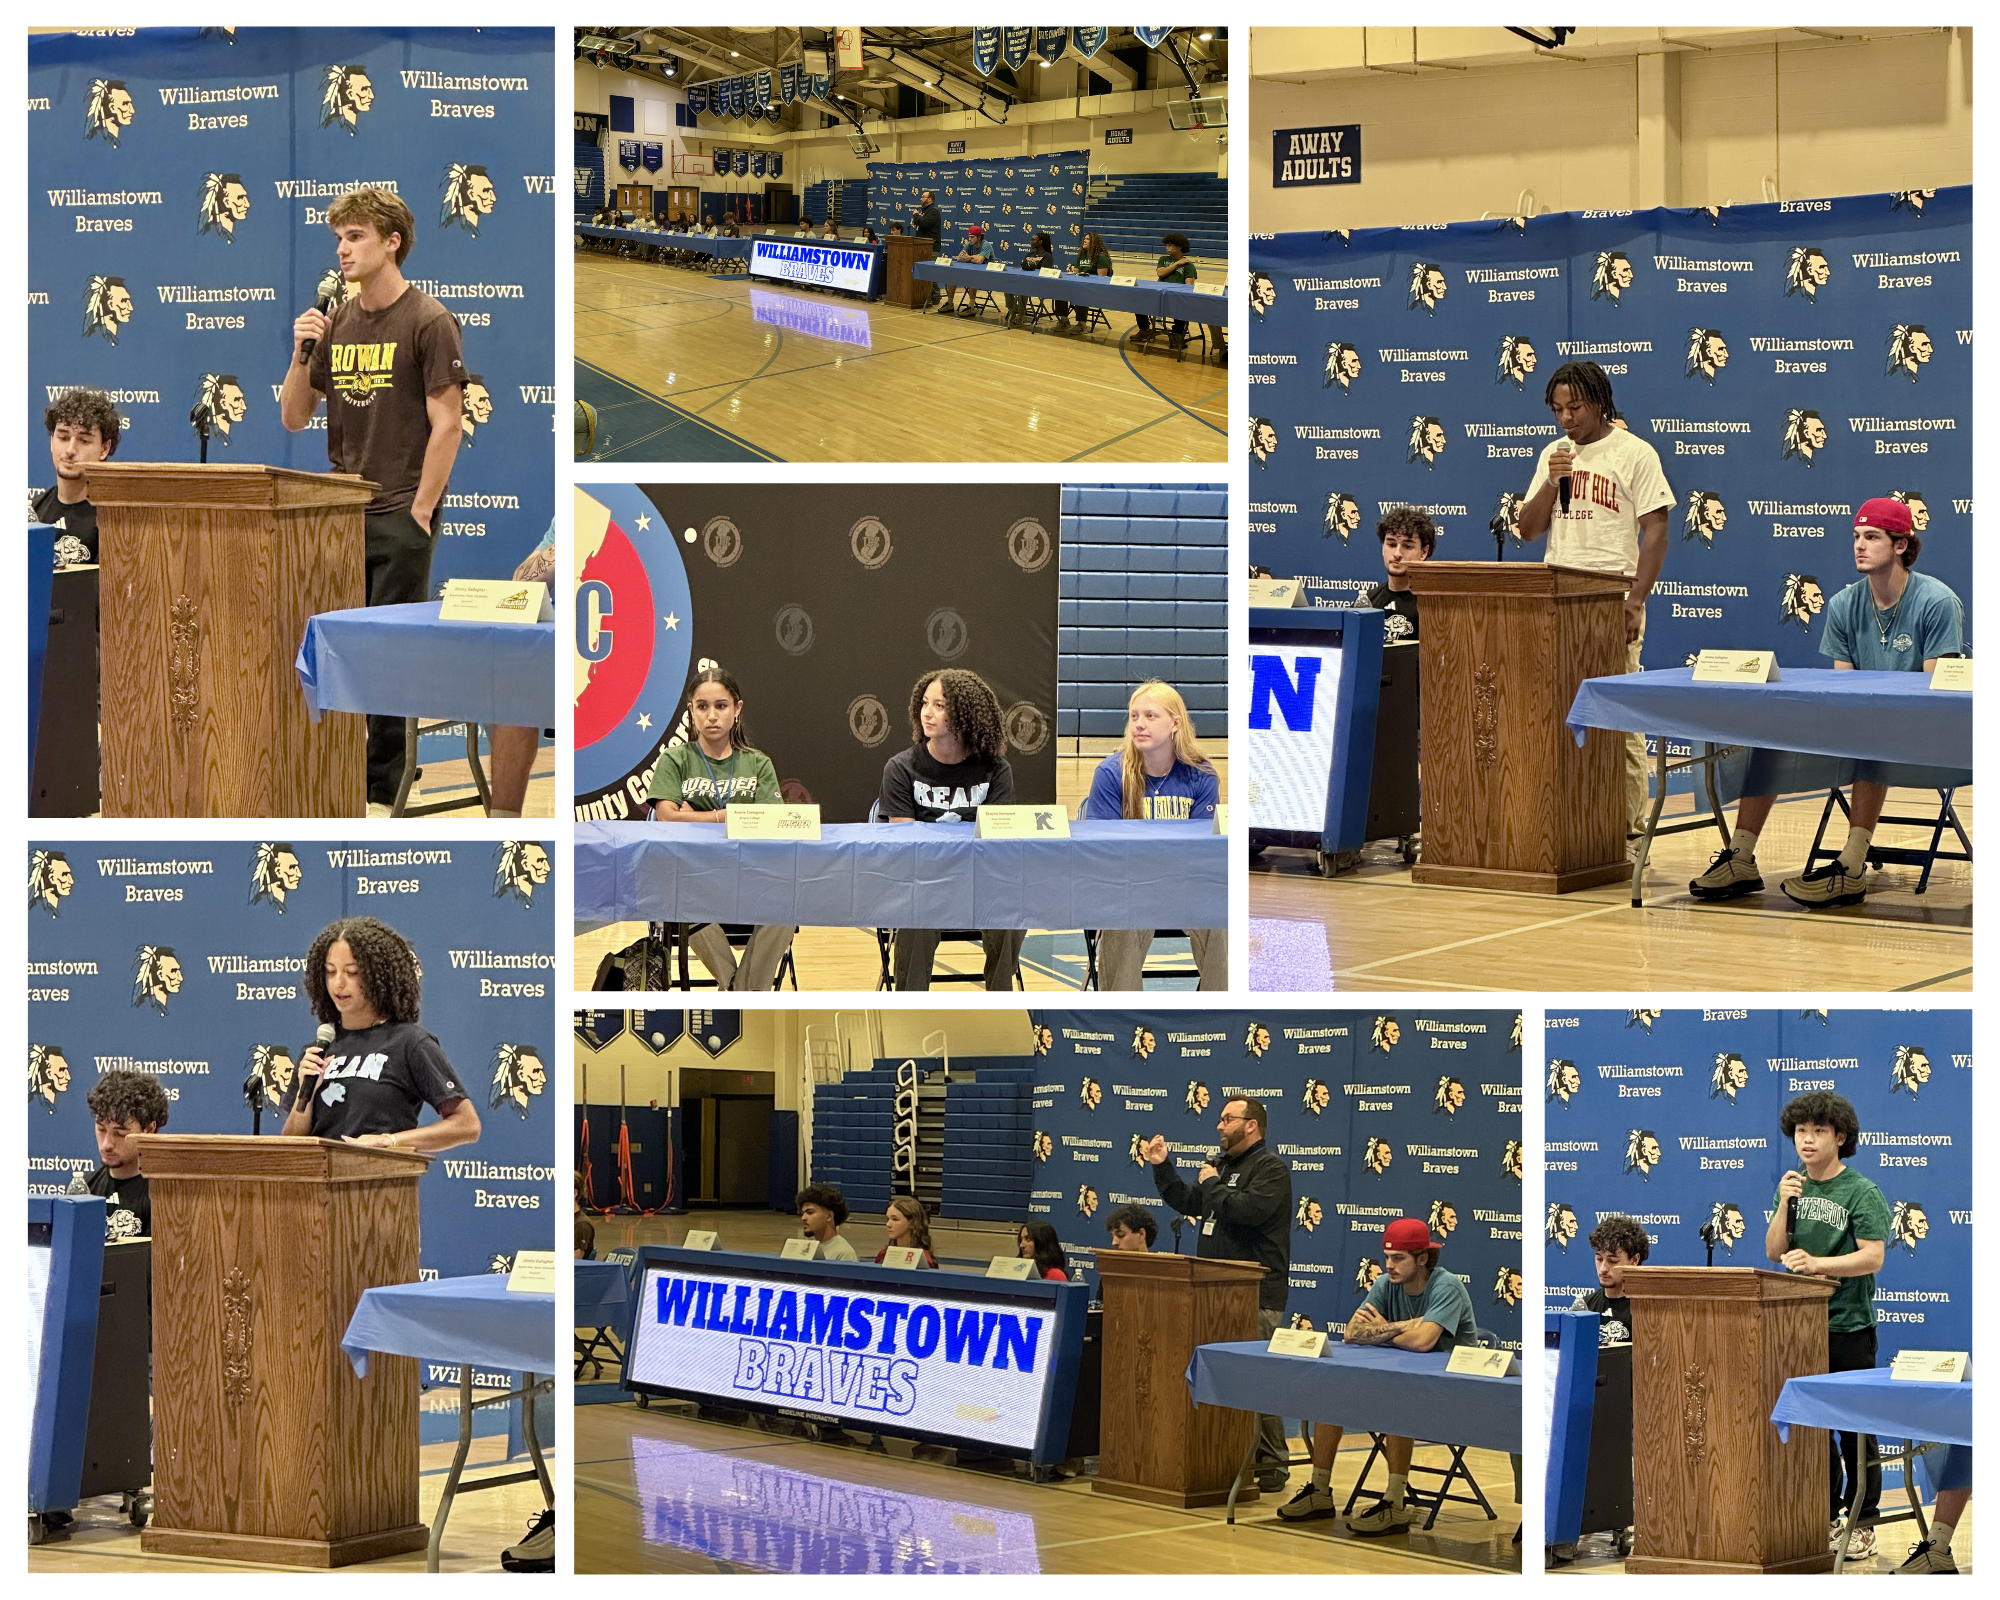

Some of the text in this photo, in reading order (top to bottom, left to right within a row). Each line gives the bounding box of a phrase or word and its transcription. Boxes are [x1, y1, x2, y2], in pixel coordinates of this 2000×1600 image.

[400, 71, 528, 90] Williamstown
[159, 86, 279, 105] Williamstown
[431, 100, 494, 118] Braves
[189, 114, 247, 130] Braves
[1288, 132, 1344, 155] AWAY
[1281, 157, 1352, 181] ADULTS
[47, 190, 162, 206] Williamstown
[1779, 200, 1831, 212] Braves
[305, 207, 331, 224] Bra
[76, 216, 132, 232] Braves
[757, 243, 870, 271] WILLIAMSTOWN
[1654, 256, 1753, 271] Williamstown
[1852, 252, 1960, 267] Williamstown
[780, 261, 834, 283] BRAVES
[1466, 268, 1559, 283] Williamstown
[1293, 278, 1381, 291] Williamstown
[1677, 279, 1727, 292] Braves
[1878, 275, 1931, 288] Braves
[157, 286, 275, 303] Williamstown
[1489, 290, 1535, 302] Braves
[1315, 298, 1358, 310] Braves
[186, 313, 244, 329] Braves
[1556, 341, 1652, 355] Williamstown
[1750, 338, 1854, 351] Williamstown
[331, 343, 397, 372] ROWAN
[1379, 349, 1468, 362] Williamstown
[1775, 360, 1826, 372] Braves
[1250, 375, 1276, 384] aves
[1401, 370, 1445, 382] Braves
[1465, 424, 1557, 438] Williamstown
[1651, 419, 1751, 432] Williamstown
[1849, 418, 1956, 432] Williamstown
[1295, 426, 1380, 438] Williamstown
[1316, 447, 1358, 459] Braves
[1487, 445, 1533, 457] Braves
[1675, 441, 1724, 454] Braves
[1875, 440, 1928, 453] Braves
[1592, 473, 1619, 513] HILL
[1748, 501, 1851, 515] Williamstown
[1250, 523, 1276, 532] aves
[1773, 524, 1824, 537] Braves
[1672, 604, 1722, 618] Braves
[681, 777, 757, 794] WAGNER
[914, 780, 990, 809] KEAN
[574, 785, 629, 823] unty
[327, 849, 451, 868] Williamstown
[97, 859, 213, 876] Williamstown
[357, 877, 419, 894] Braves
[126, 885, 183, 901] Braves
[207, 956, 307, 973] Williamsto
[449, 951, 555, 968] Williamsto
[29, 961, 98, 974] amstown
[237, 983, 296, 1000] Braves
[480, 979, 544, 997] Braves
[29, 989, 69, 1001] raves
[1703, 1011, 1747, 1021] Braves
[1284, 1028, 1348, 1038] Williamstown
[1415, 1020, 1486, 1033] Williamstown
[1062, 1029, 1114, 1041] Williamstown
[1168, 1033, 1226, 1042] Williamstown
[1075, 1044, 1101, 1054] Braves
[1298, 1044, 1331, 1053] Braves
[1431, 1038, 1466, 1049] Braves
[1181, 1047, 1210, 1056] Braves
[324, 1053, 389, 1082] EAN
[1767, 1058, 1858, 1071] Williamstown
[1598, 1065, 1683, 1078] Williamstown
[1113, 1085, 1167, 1098] Williamstown
[1344, 1084, 1410, 1094] Williamstown
[1481, 1084, 1522, 1095] William
[1619, 1085, 1661, 1097] Braves
[1789, 1079, 1834, 1091] Braves
[1033, 1100, 1052, 1108] raves
[1126, 1100, 1153, 1110] Braves
[1359, 1101, 1392, 1110] Braves
[1498, 1102, 1522, 1112] Brav
[1062, 1136, 1112, 1149] Williamstown
[1679, 1137, 1767, 1149] Williamstown
[1859, 1133, 1952, 1145] Williamstown
[1277, 1145, 1341, 1154] Williamstown
[1407, 1145, 1478, 1157] Williamstown
[1546, 1142, 1598, 1151] amstown
[1074, 1151, 1098, 1161] Braves
[1880, 1153, 1927, 1166] Braves
[1292, 1161, 1324, 1170] Braves
[1423, 1162, 1458, 1173] Braves
[1700, 1157, 1744, 1169] Braves
[444, 1161, 555, 1180] Williamstow
[475, 1190, 539, 1208] Braves
[1336, 1204, 1403, 1217] Williamstown
[1473, 1210, 1522, 1222] Williams
[1069, 1258, 1094, 1269] Braves
[1546, 1286, 1595, 1297] amstown
[1877, 1309, 1924, 1322] Braves
[656, 1276, 1043, 1373] WILLIAMSTOWN
[733, 1338, 919, 1416] BRAVES
